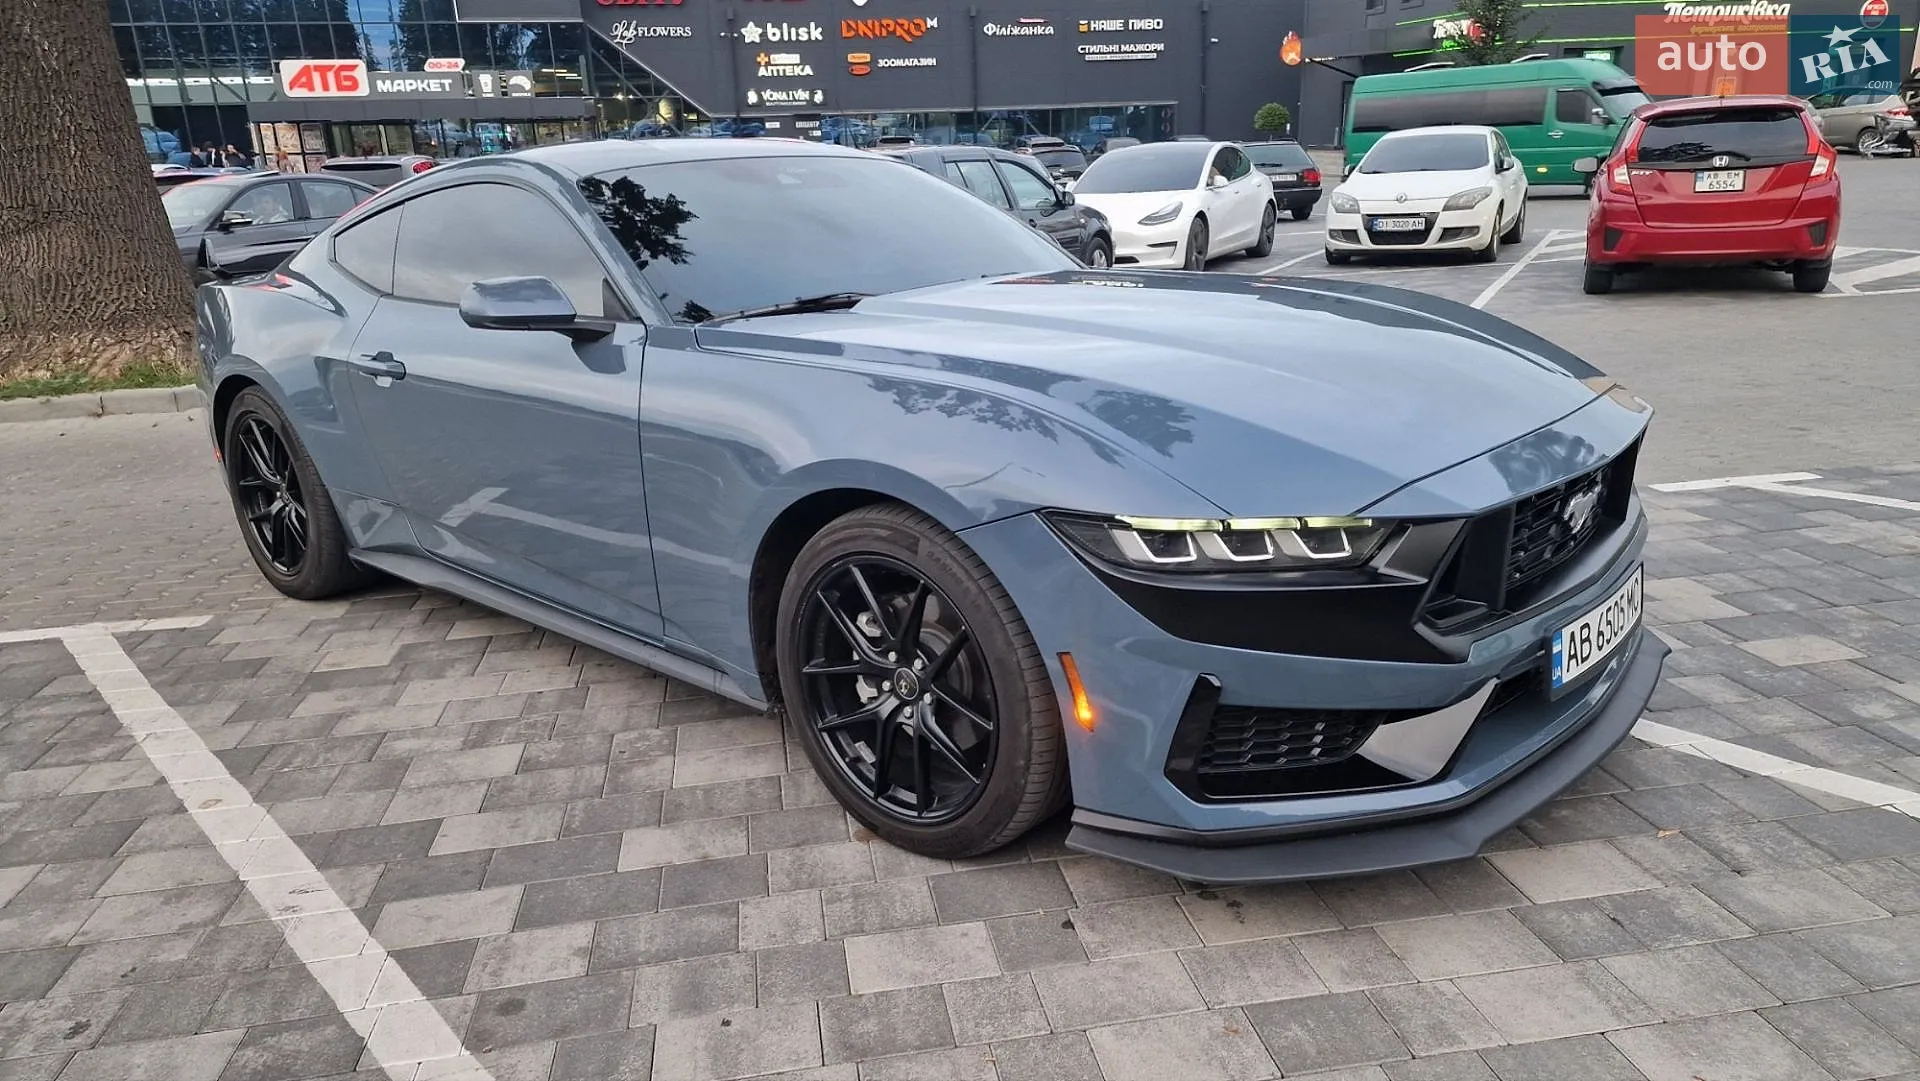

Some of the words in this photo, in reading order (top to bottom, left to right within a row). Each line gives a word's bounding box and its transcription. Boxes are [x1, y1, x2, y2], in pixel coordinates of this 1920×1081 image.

[1664, 0, 1790, 26] Петриківка
[983, 23, 1055, 36] Філіжанка
[1090, 20, 1124, 31] НАШЕ
[1128, 19, 1163, 30] ПИВО
[638, 27, 692, 37] FLOWERS
[1077, 45, 1119, 54] СТИЛЬНІ
[1120, 43, 1164, 52] МАЖОРИ
[878, 58, 937, 67] ЗООМАГАЗИН
[758, 64, 814, 77] АПТЕКА
[289, 64, 359, 92] АТБ
[376, 79, 452, 93] МАРКЕТ
[1708, 180, 1736, 190] 6554
[1566, 622, 1593, 673] AB
[1596, 594, 1626, 652] 6505
